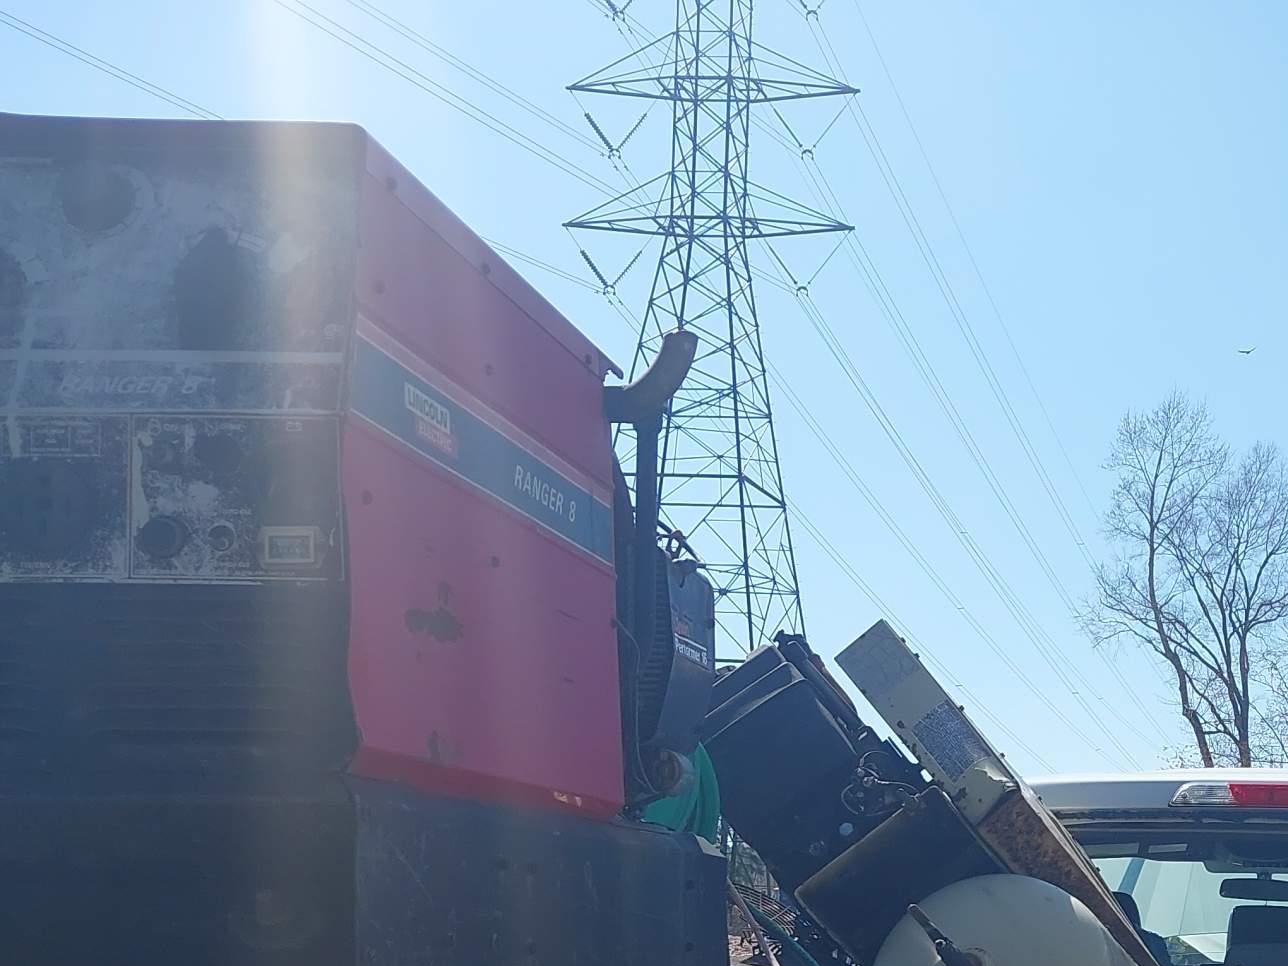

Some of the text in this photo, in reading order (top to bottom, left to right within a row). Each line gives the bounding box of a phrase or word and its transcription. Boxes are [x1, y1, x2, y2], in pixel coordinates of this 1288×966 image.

[407, 386, 449, 430] LINCOLN
[514, 465, 577, 523] RANGER 8
